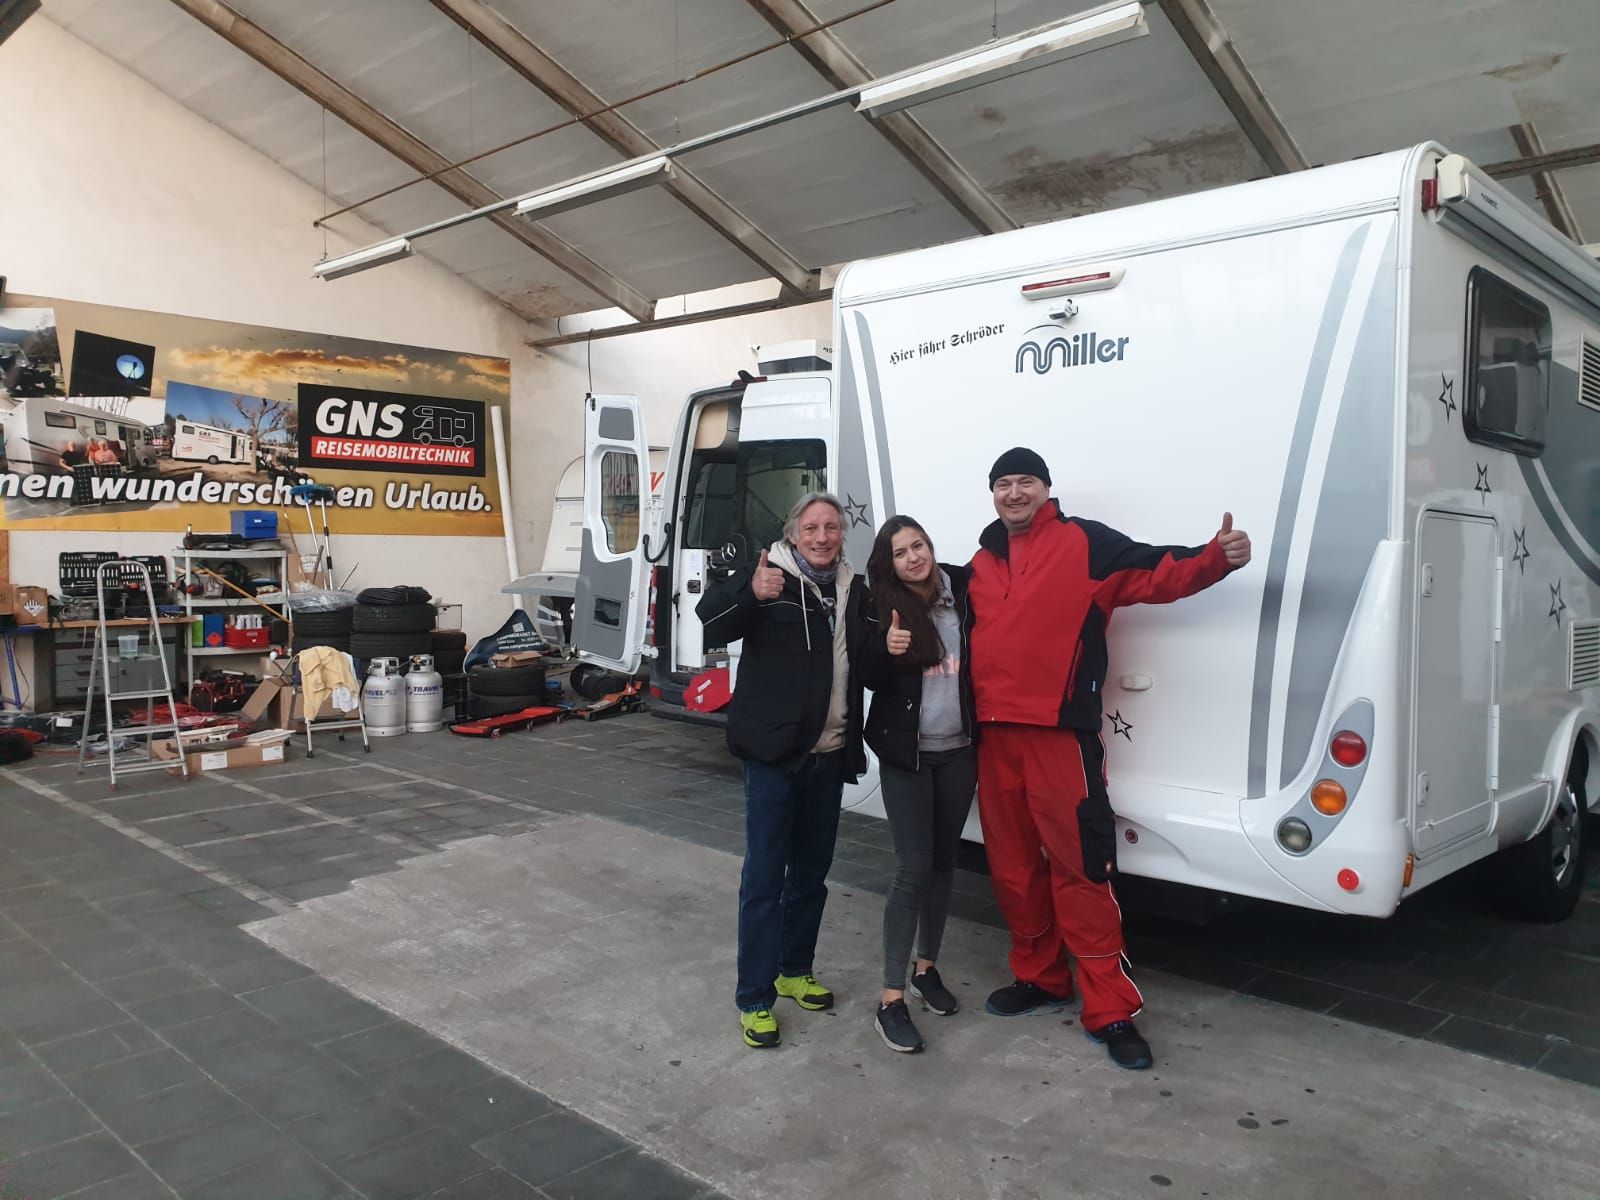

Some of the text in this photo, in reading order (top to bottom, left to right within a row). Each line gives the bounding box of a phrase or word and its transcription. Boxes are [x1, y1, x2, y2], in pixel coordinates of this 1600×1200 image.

[889, 323, 1005, 365] Hier fährt Schröder
[1015, 331, 1129, 375] Miller
[315, 398, 407, 439] GNS
[315, 440, 471, 464] REISEMOBILTECHNIK
[0, 472, 492, 512] nen wunderschöen Urlaub.
